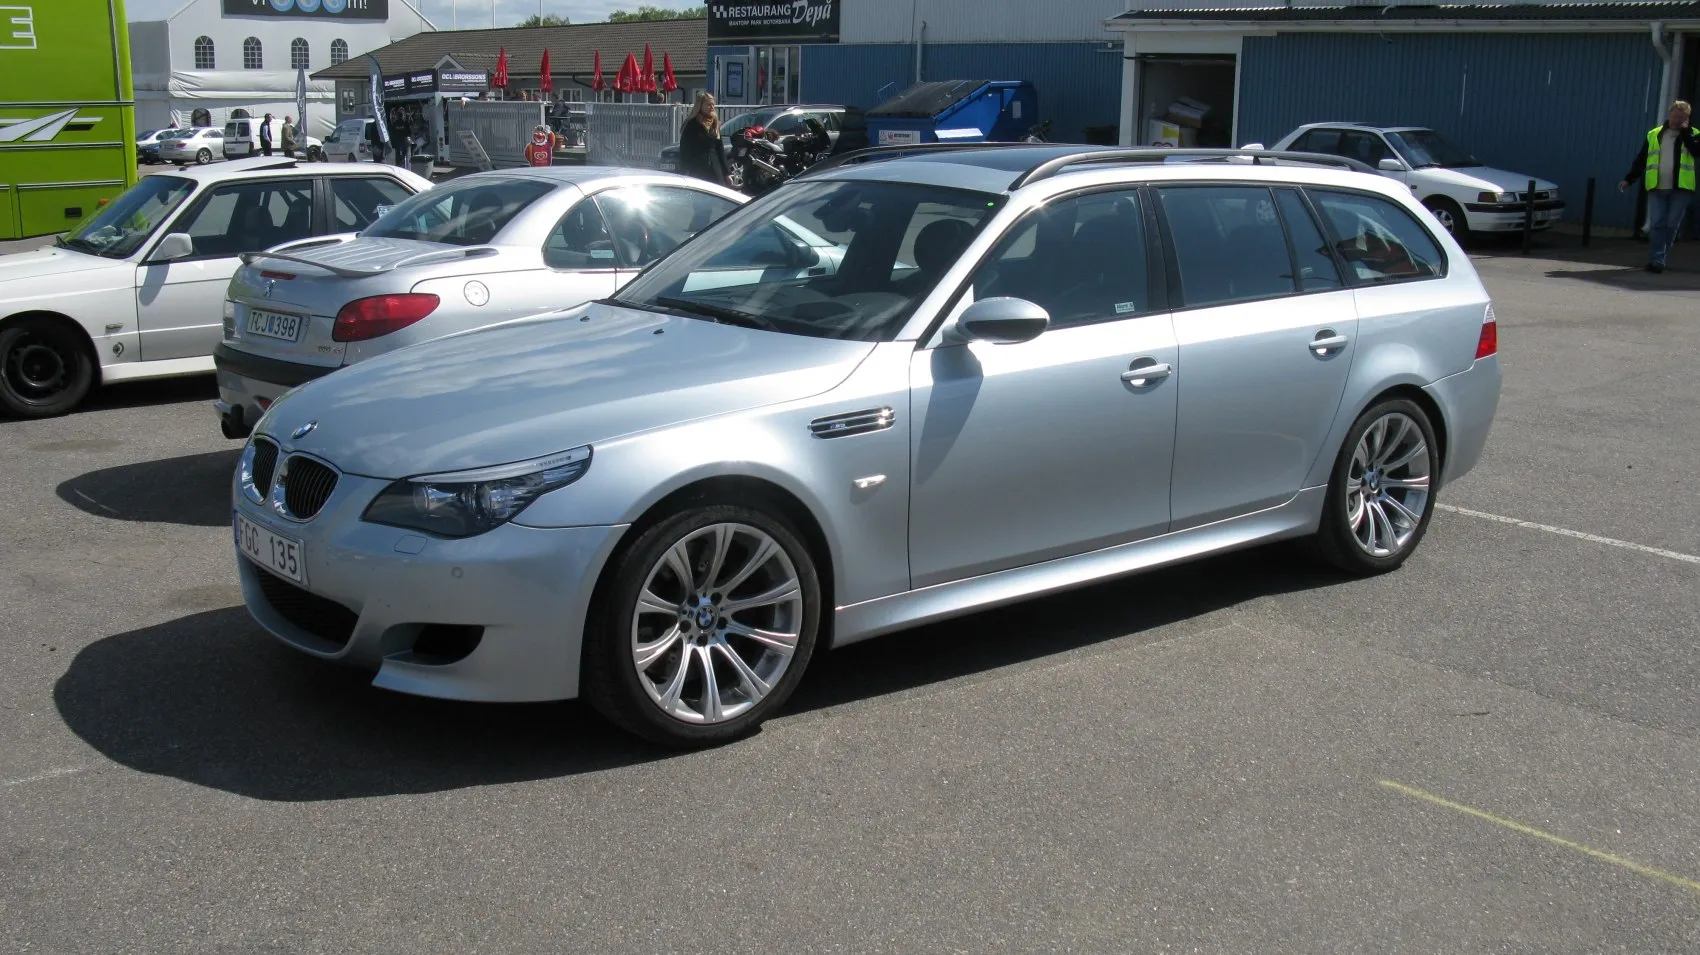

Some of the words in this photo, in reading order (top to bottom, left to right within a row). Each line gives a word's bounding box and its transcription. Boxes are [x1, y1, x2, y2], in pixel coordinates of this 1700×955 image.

[729, 4, 791, 18] RESTAURANG
[792, 0, 831, 27] Depå
[250, 311, 270, 332] TCJ
[274, 316, 296, 337] 398
[239, 517, 259, 556] FGC
[270, 536, 297, 575] 135
